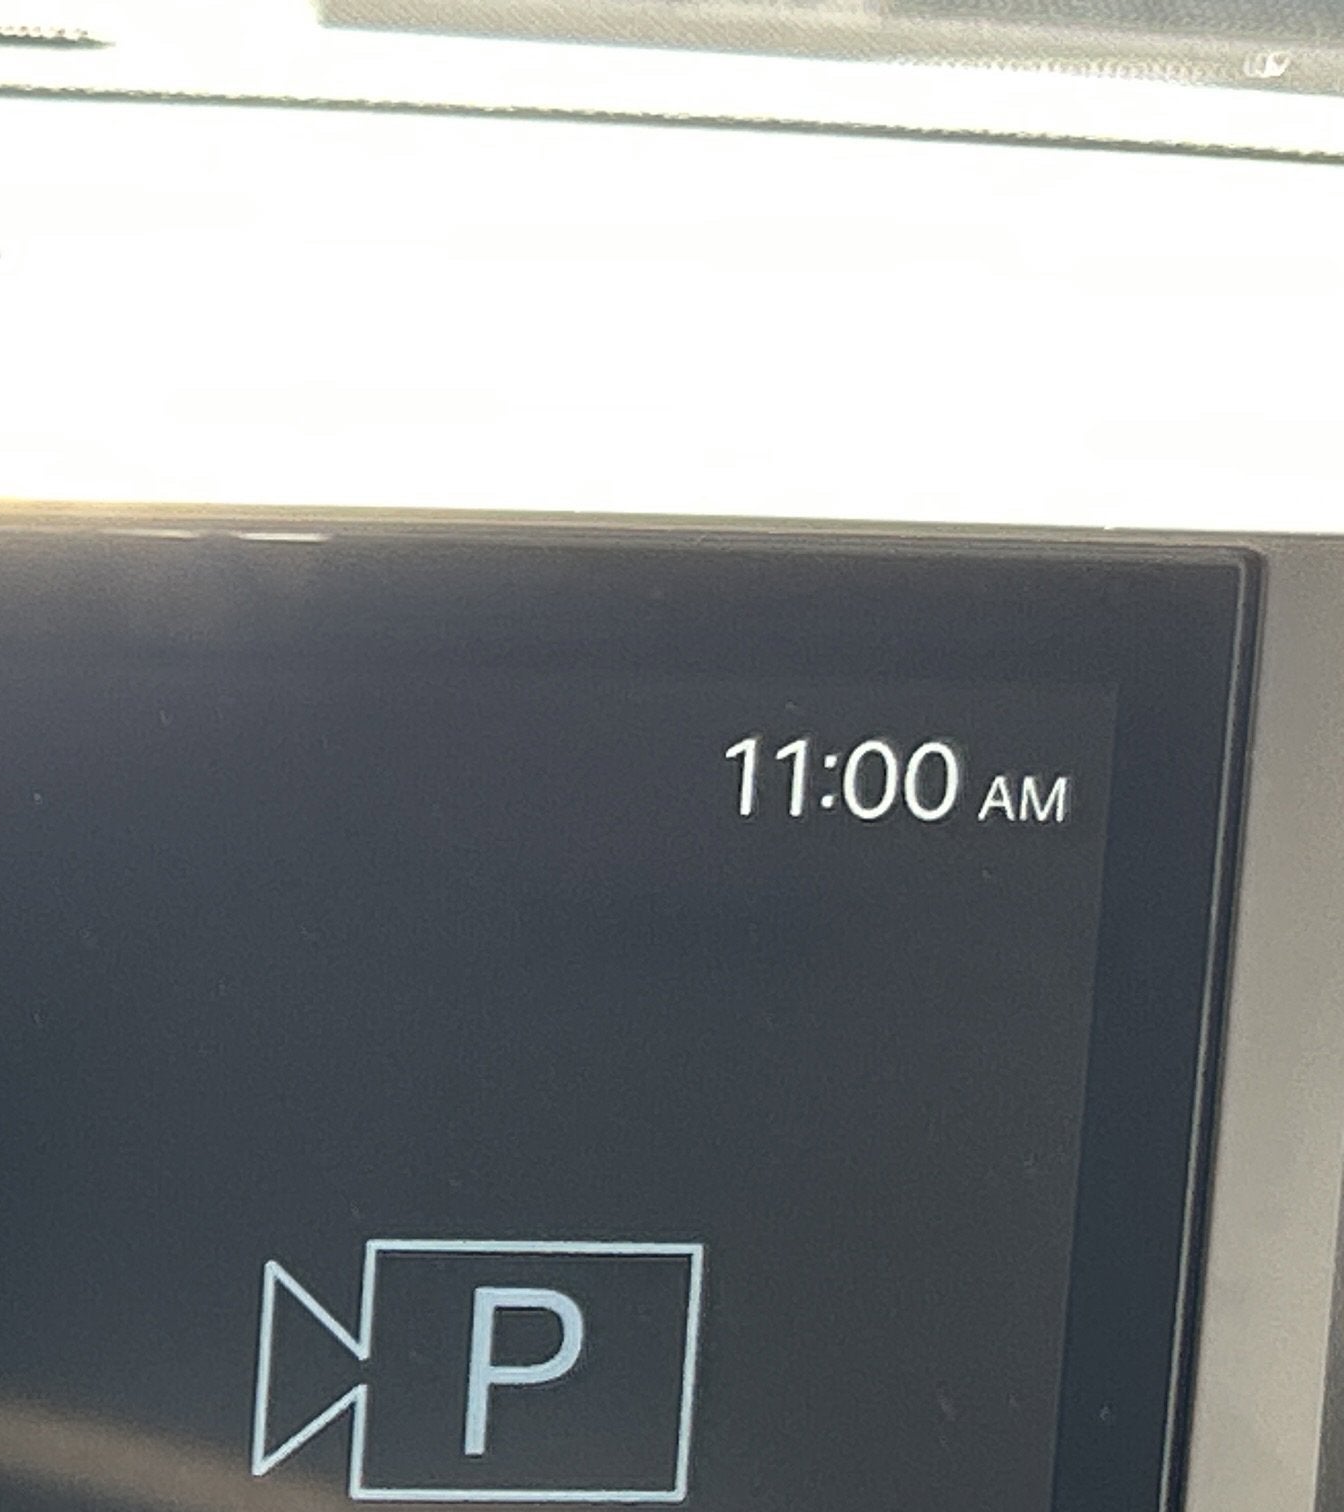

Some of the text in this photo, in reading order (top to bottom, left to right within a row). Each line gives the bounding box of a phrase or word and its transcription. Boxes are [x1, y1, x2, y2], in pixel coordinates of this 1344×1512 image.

[723, 737, 1070, 823] 11:00 AM
[464, 1286, 585, 1456] P
